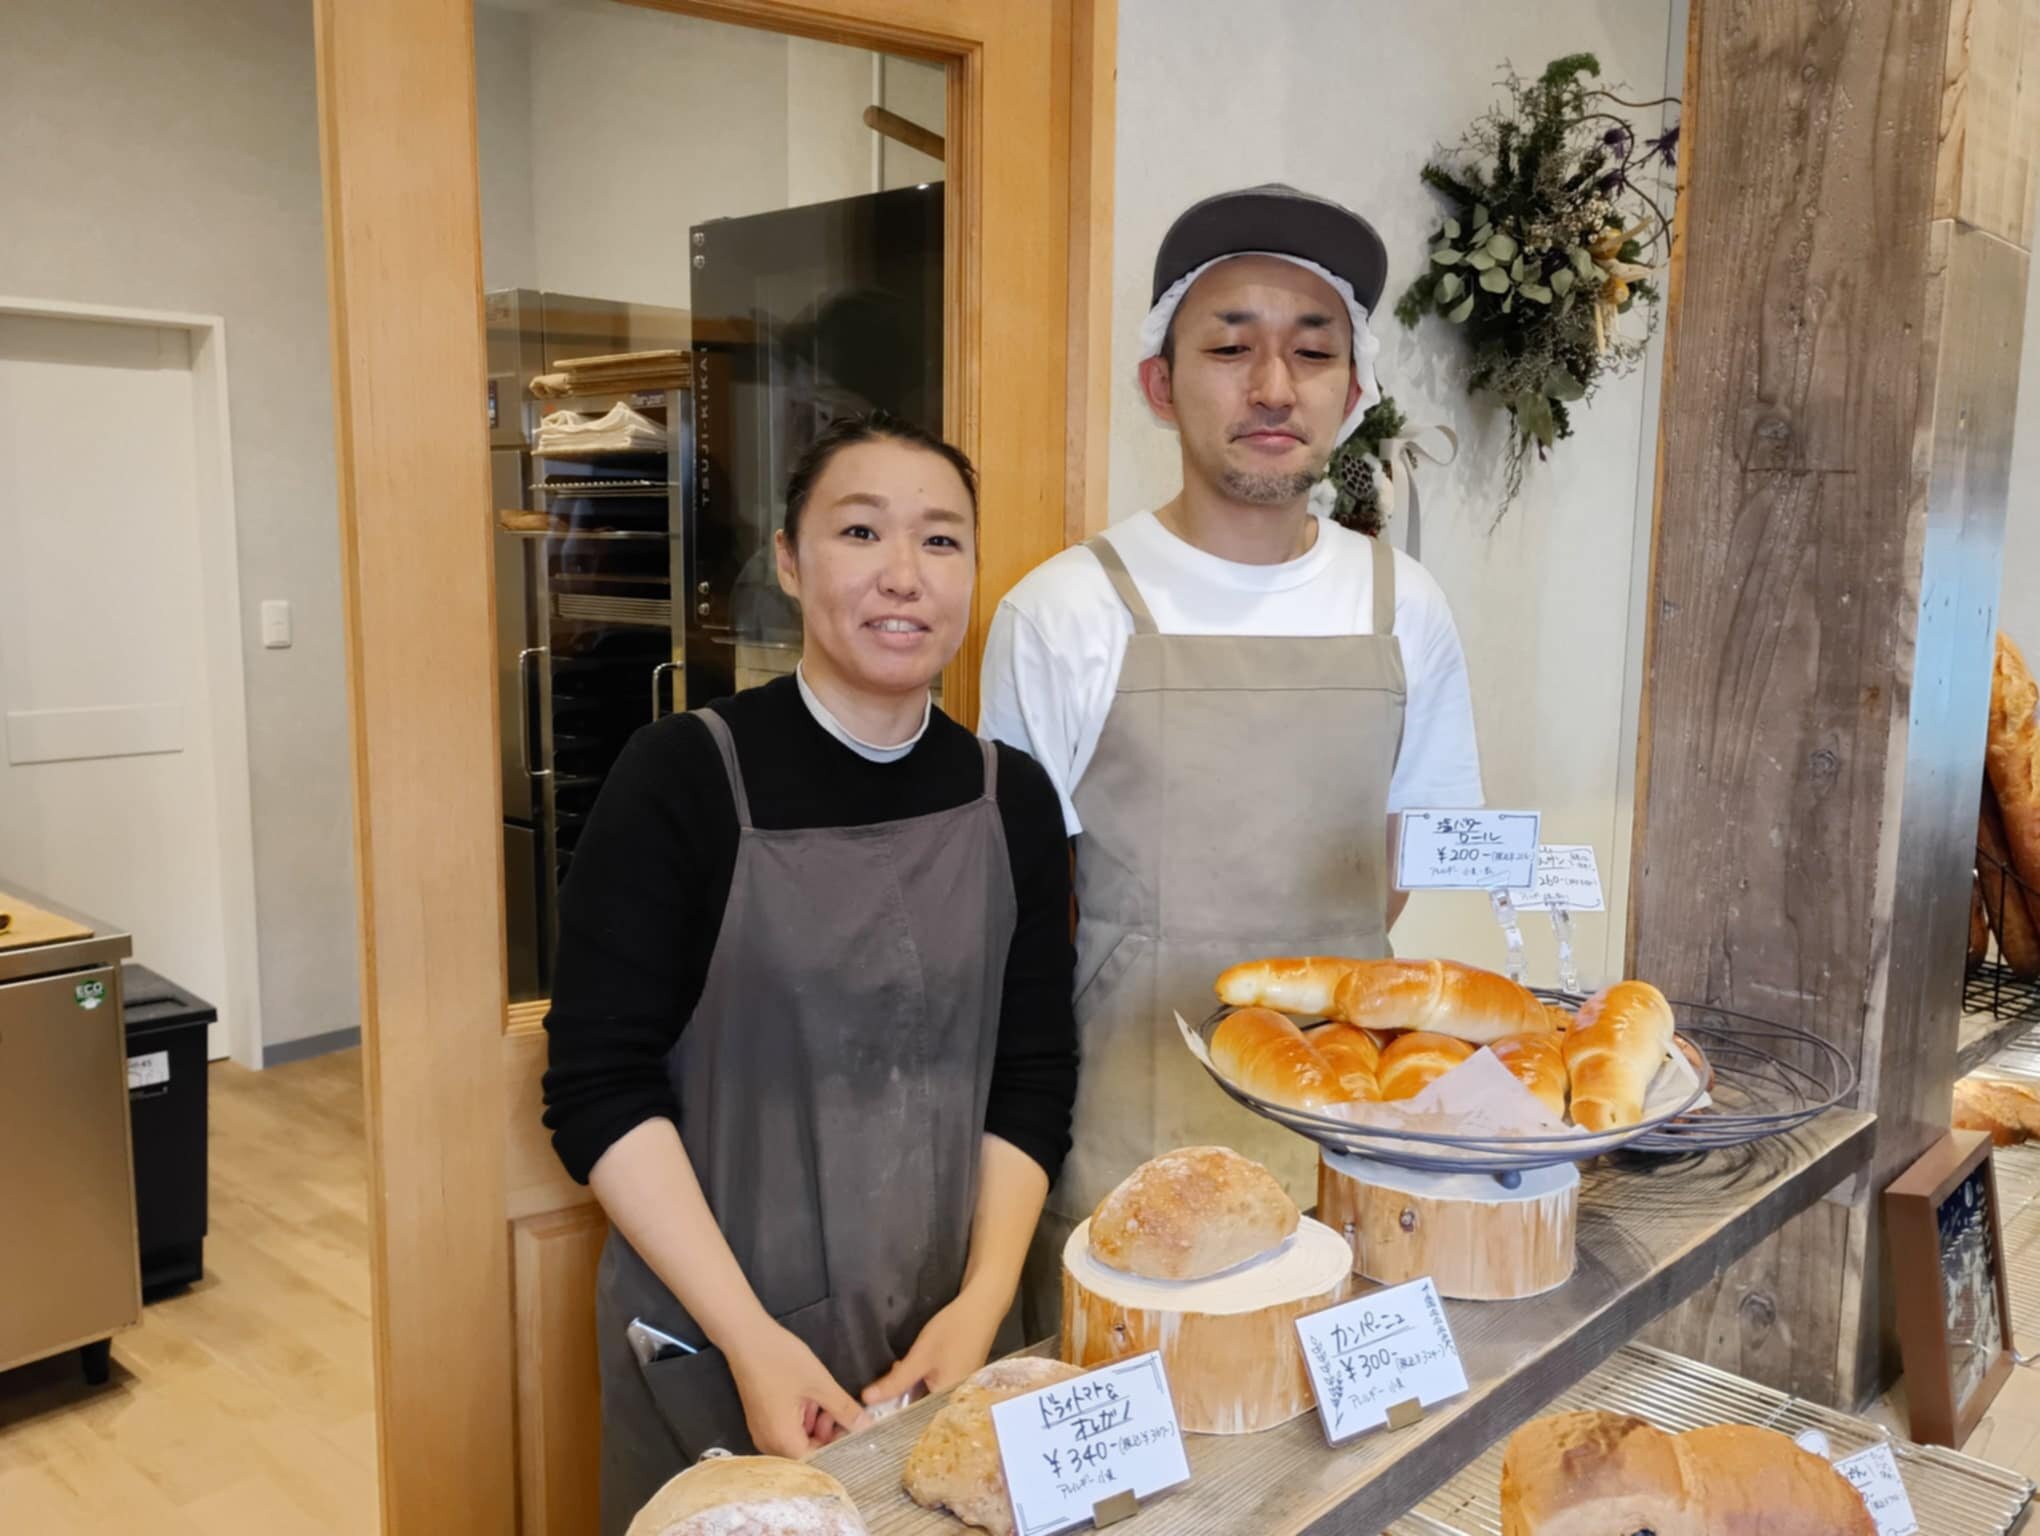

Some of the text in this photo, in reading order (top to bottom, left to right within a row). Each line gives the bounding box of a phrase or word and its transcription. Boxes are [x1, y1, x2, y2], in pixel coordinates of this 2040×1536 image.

[76, 982, 103, 998] ECO
[1330, 1311, 1405, 1353] カンパーニュ
